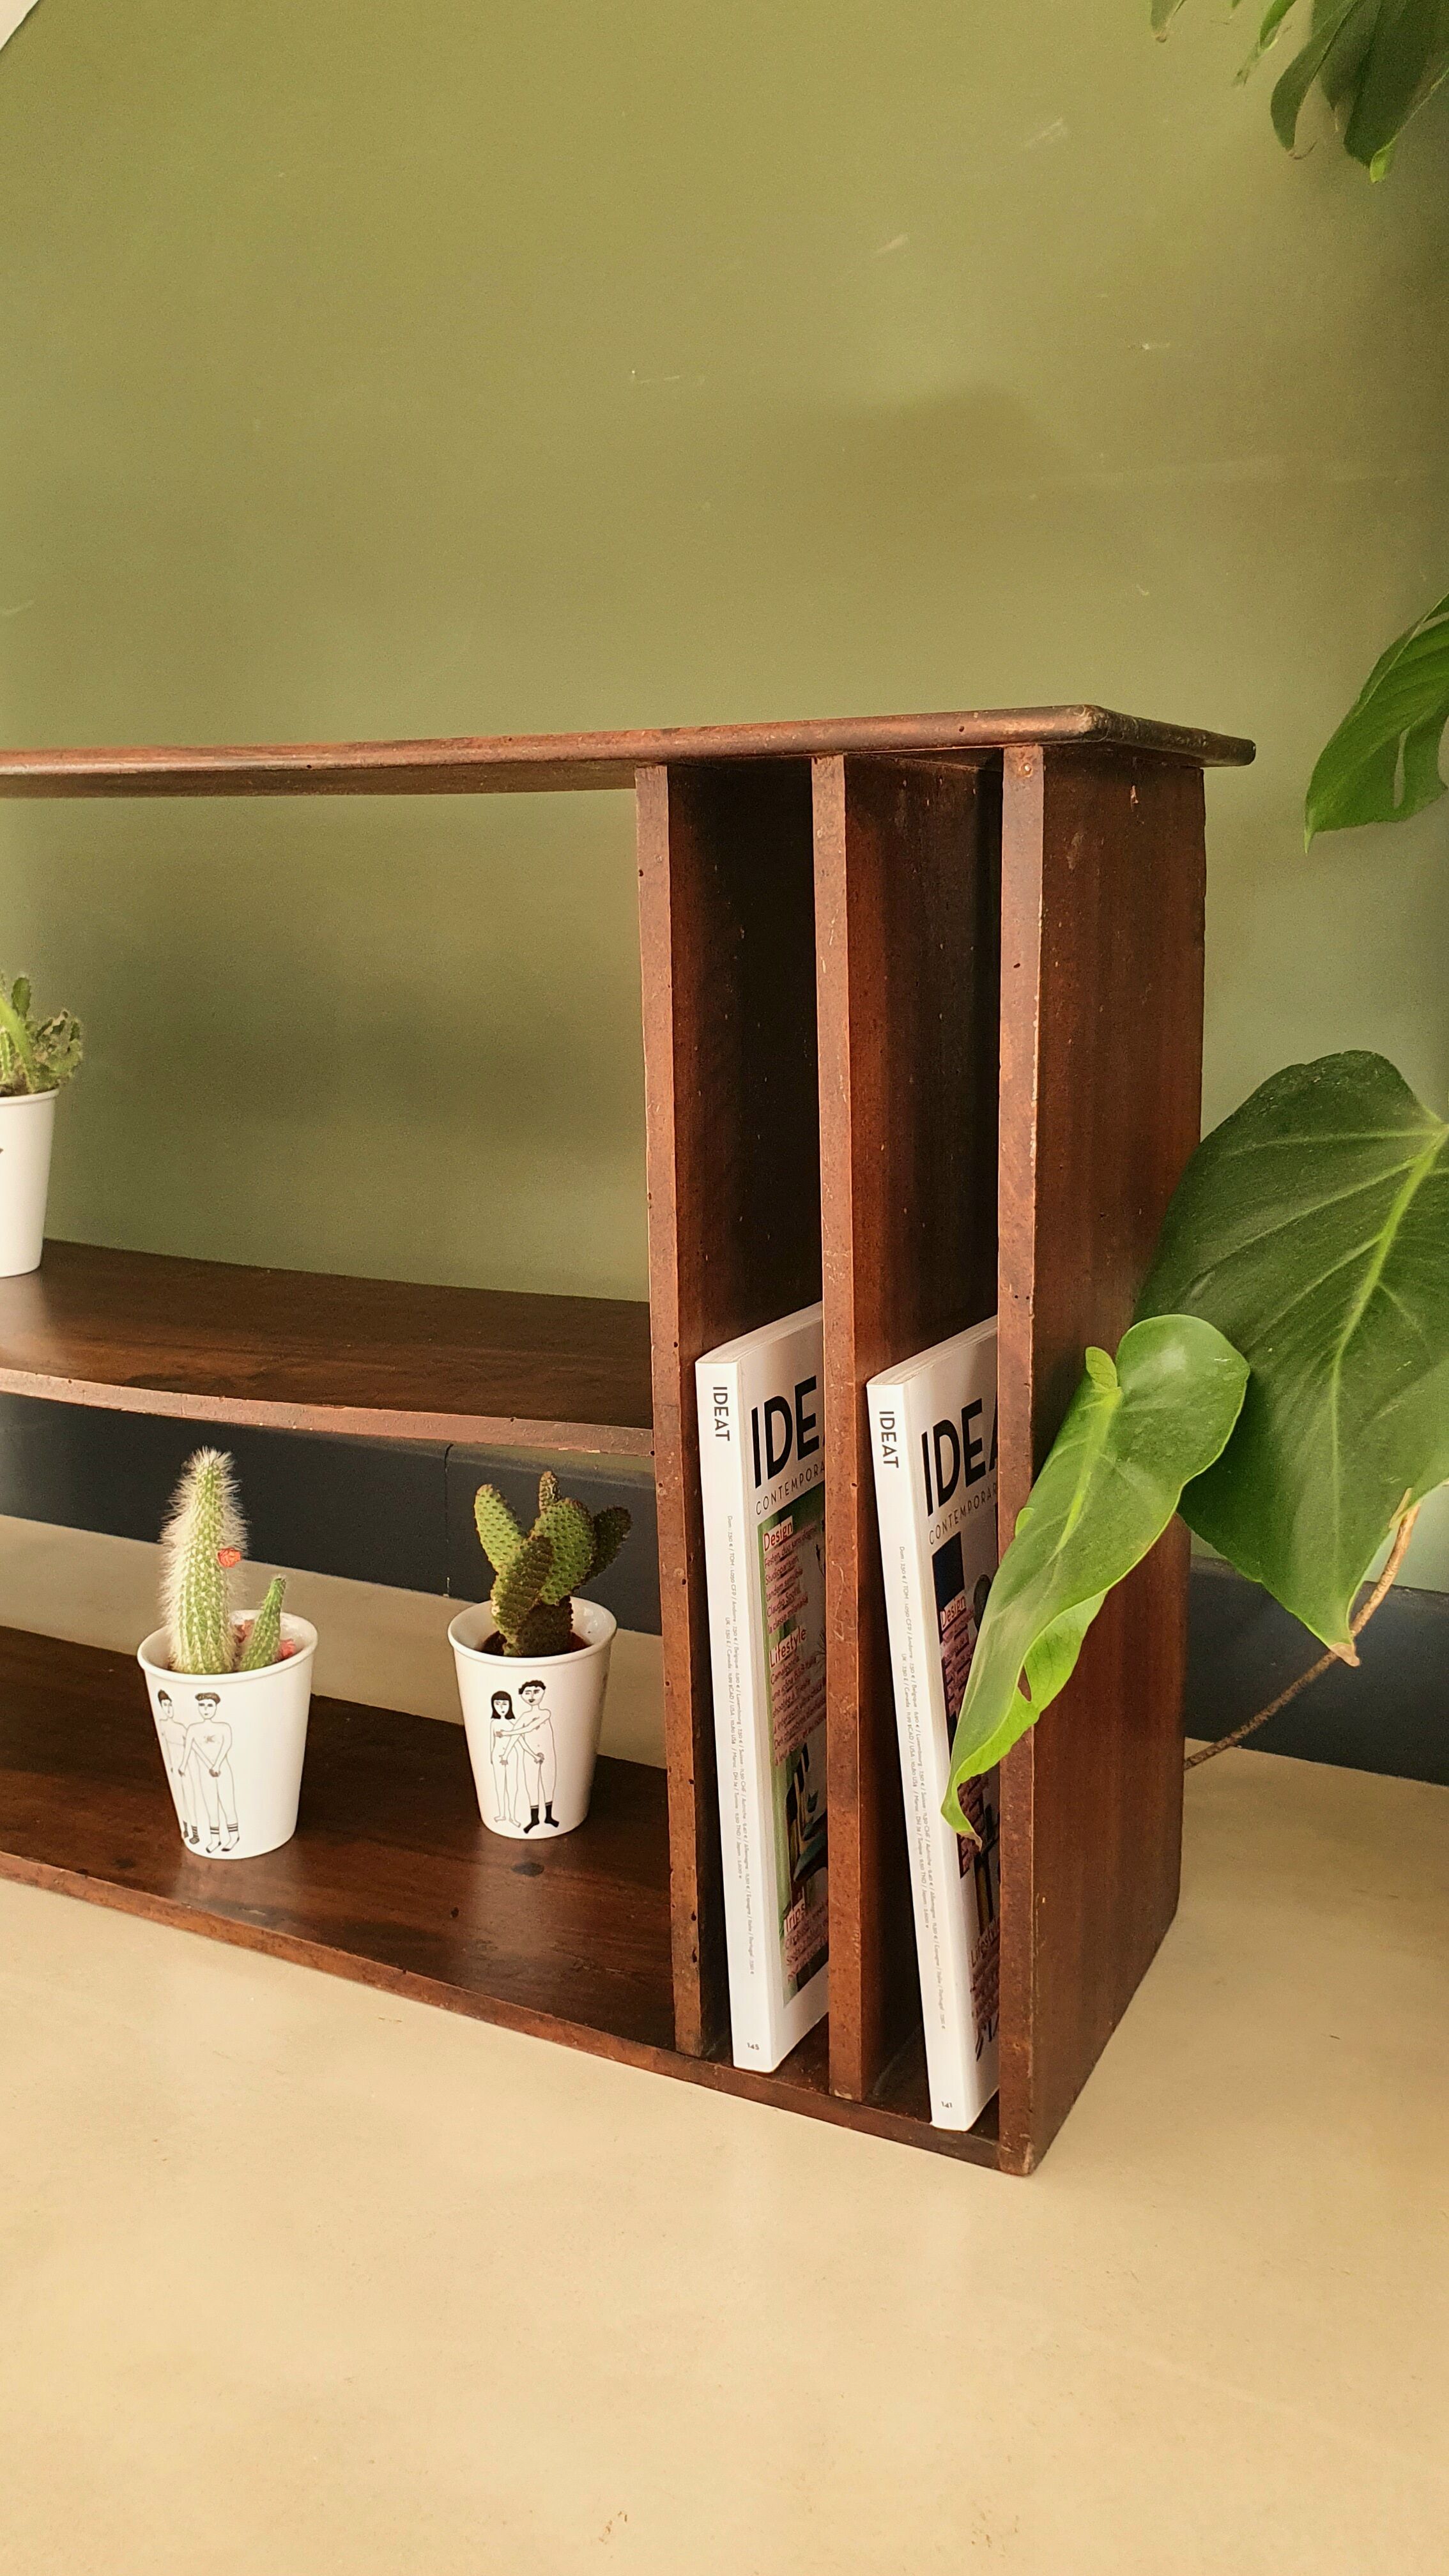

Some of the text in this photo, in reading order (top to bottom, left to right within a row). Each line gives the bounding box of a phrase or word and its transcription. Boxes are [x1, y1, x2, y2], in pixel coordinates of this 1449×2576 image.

[713, 1386, 730, 1441] IDEAT
[751, 1376, 825, 1489] IDE
[879, 1411, 899, 1468] IDEAT
[764, 1522, 792, 1551] Design
[942, 1596, 966, 1627] Design
[770, 1625, 806, 1667] Lifestyle
[747, 2042, 760, 2050] 145
[940, 2100, 953, 2108] 141
